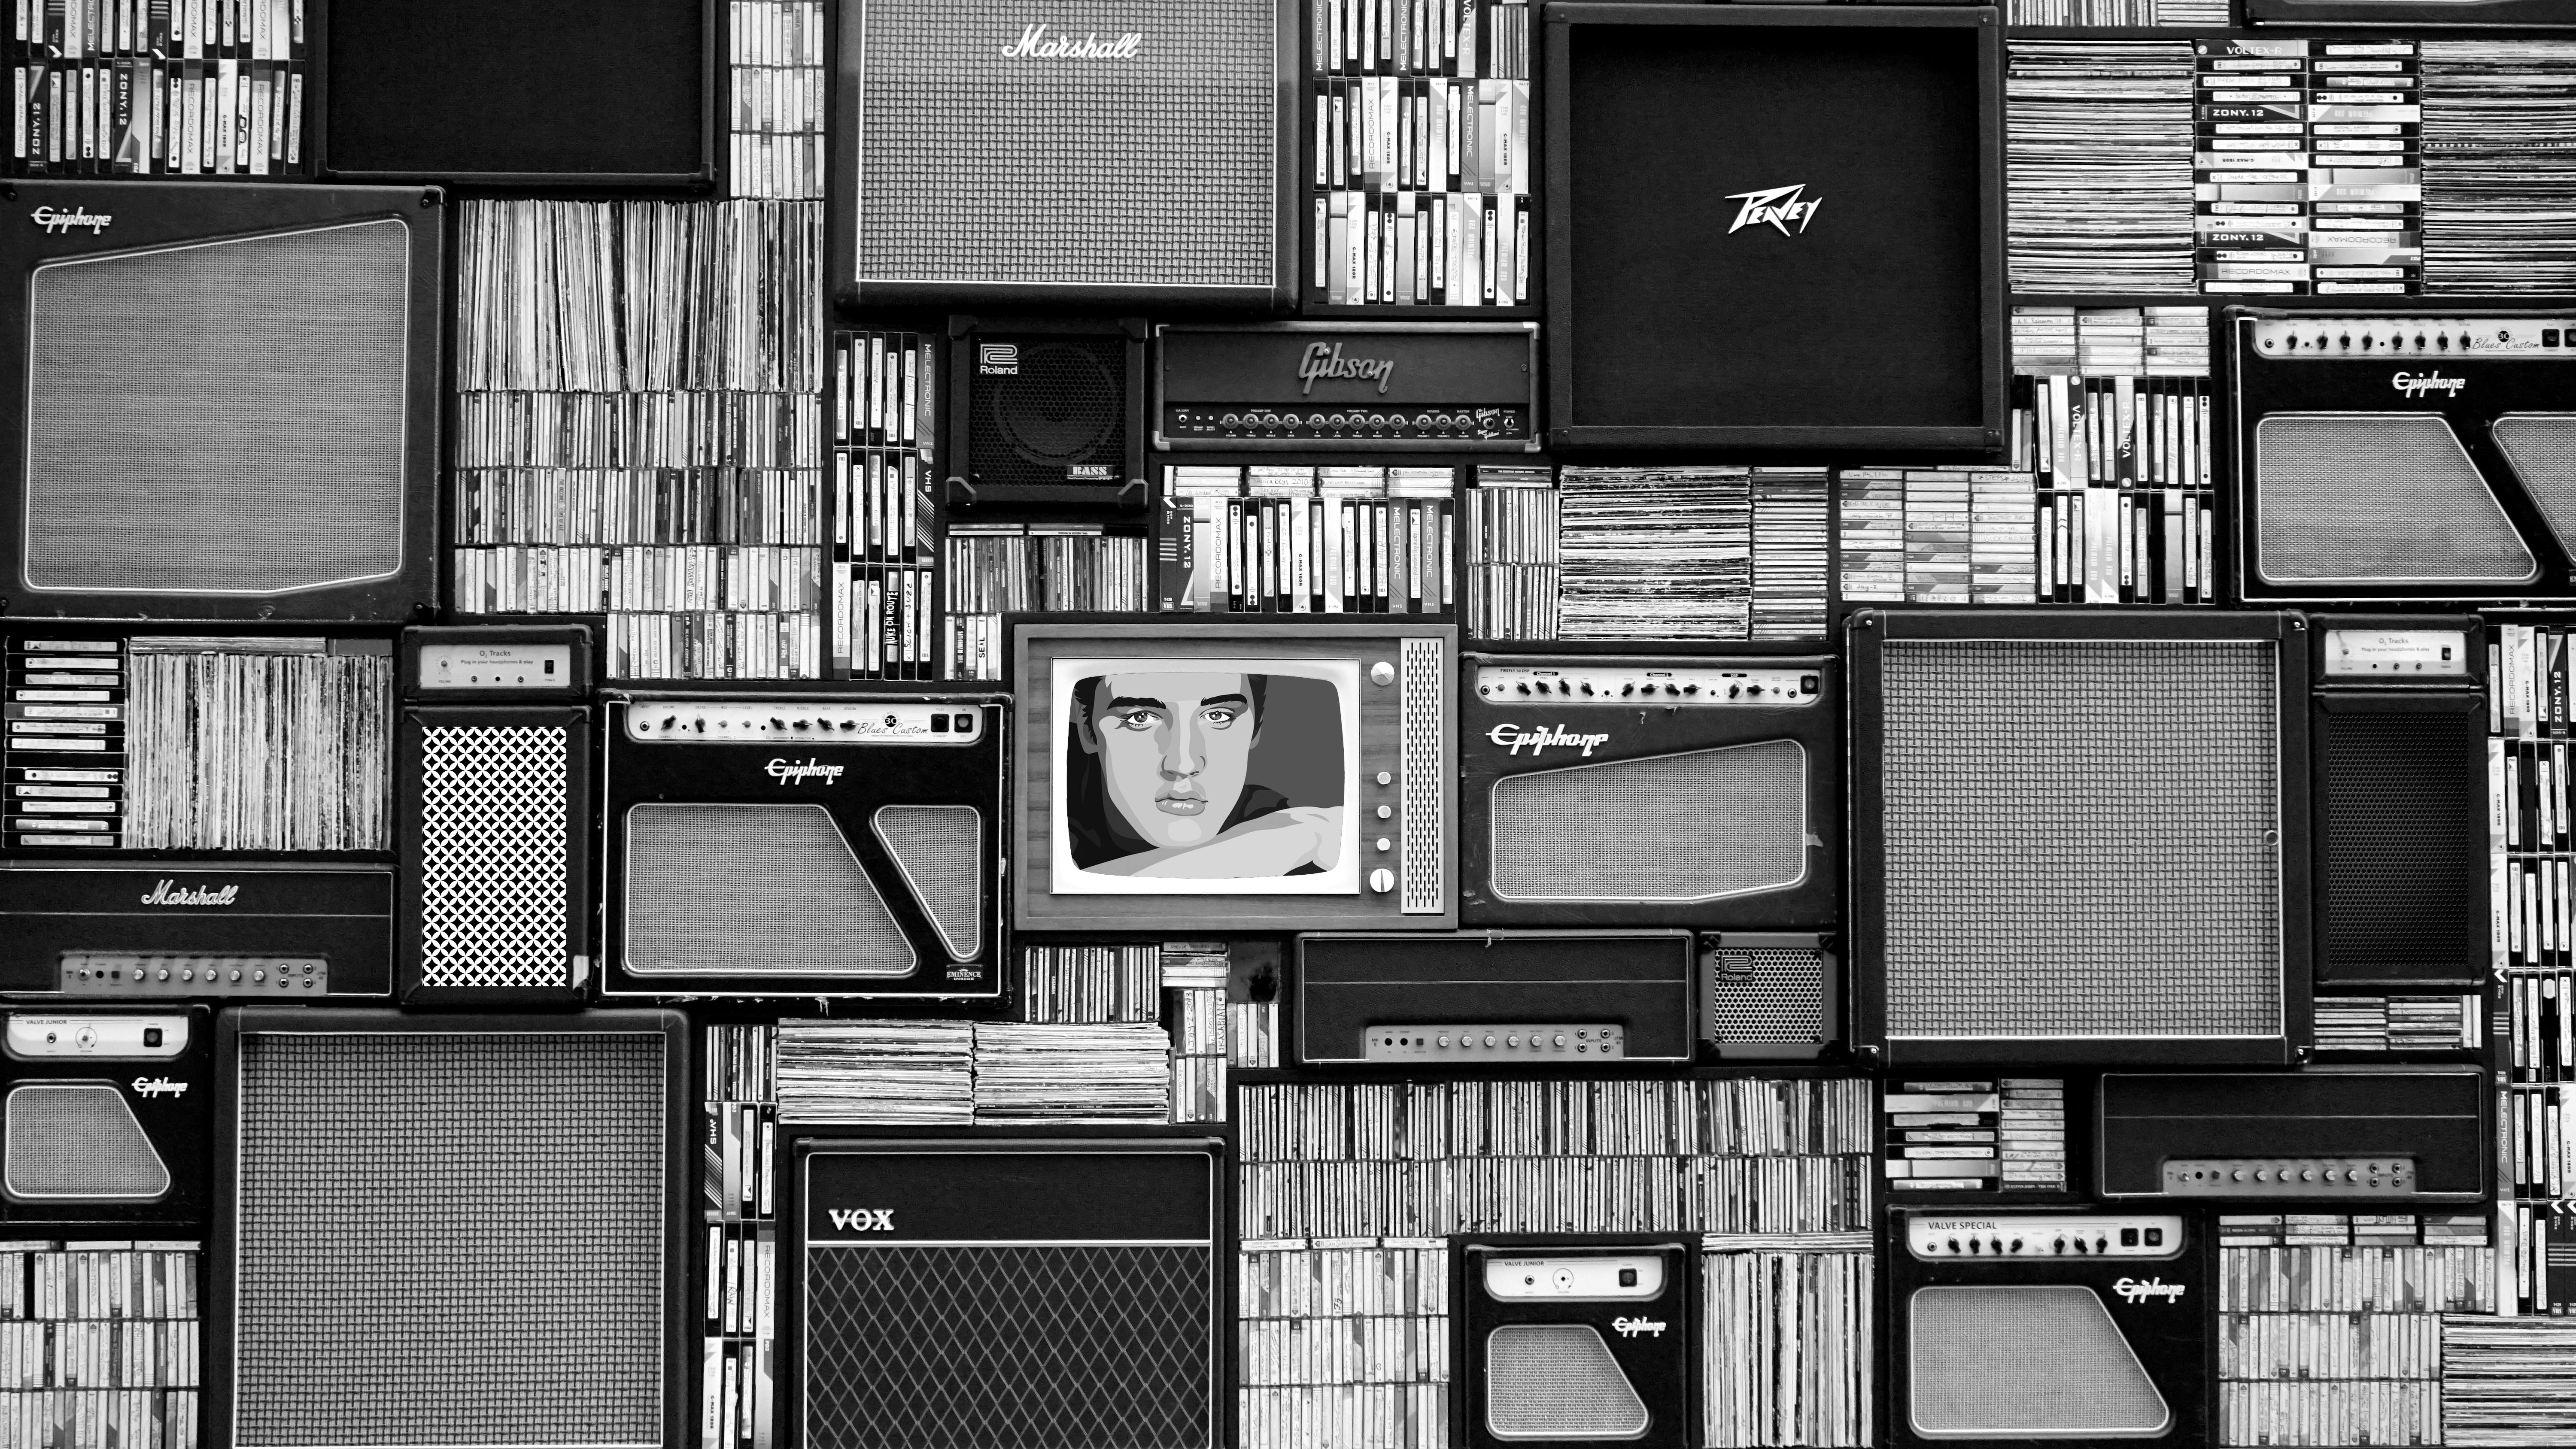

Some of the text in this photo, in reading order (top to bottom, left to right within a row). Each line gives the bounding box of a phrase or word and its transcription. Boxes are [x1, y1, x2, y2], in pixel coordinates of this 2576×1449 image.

[1002, 23, 1142, 59] Marshall
[2226, 46, 2282, 55] VOLTEX-R
[187, 83, 195, 155] RECORDOMAX
[256, 84, 264, 155] RECORDOMAX
[2213, 109, 2264, 117] ZONY.12
[30, 206, 112, 235] Epiphone
[2472, 338, 2540, 349] Blues Custom
[980, 366, 1018, 375] Roland
[1298, 342, 1394, 395] Gibson
[2392, 371, 2466, 398] Epiphone
[1476, 407, 1500, 422] Gibson
[2072, 405, 2082, 461] VOLTEX-R
[2122, 401, 2131, 458] VOLTEX-R
[1072, 466, 1108, 476] BASS
[1183, 516, 1191, 569] ZONY.12
[885, 591, 899, 646] NUKE ON ROUTE
[2554, 671, 2563, 723] ZONY.12
[857, 723, 928, 734] Blues Custom
[1485, 723, 1610, 757] Epiphone
[765, 758, 844, 785] Epiphone
[141, 879, 239, 905] Marshall
[1721, 973, 1753, 982] Roland
[1216, 1003, 1226, 1047] KASABIAN
[131, 1077, 188, 1098] Epiphone
[829, 1208, 895, 1231] VOX
[1928, 1221, 1997, 1230] VALVE SPECIAL
[2112, 1277, 2186, 1303] Epiphone
[1612, 1316, 1666, 1337] Epiphone
